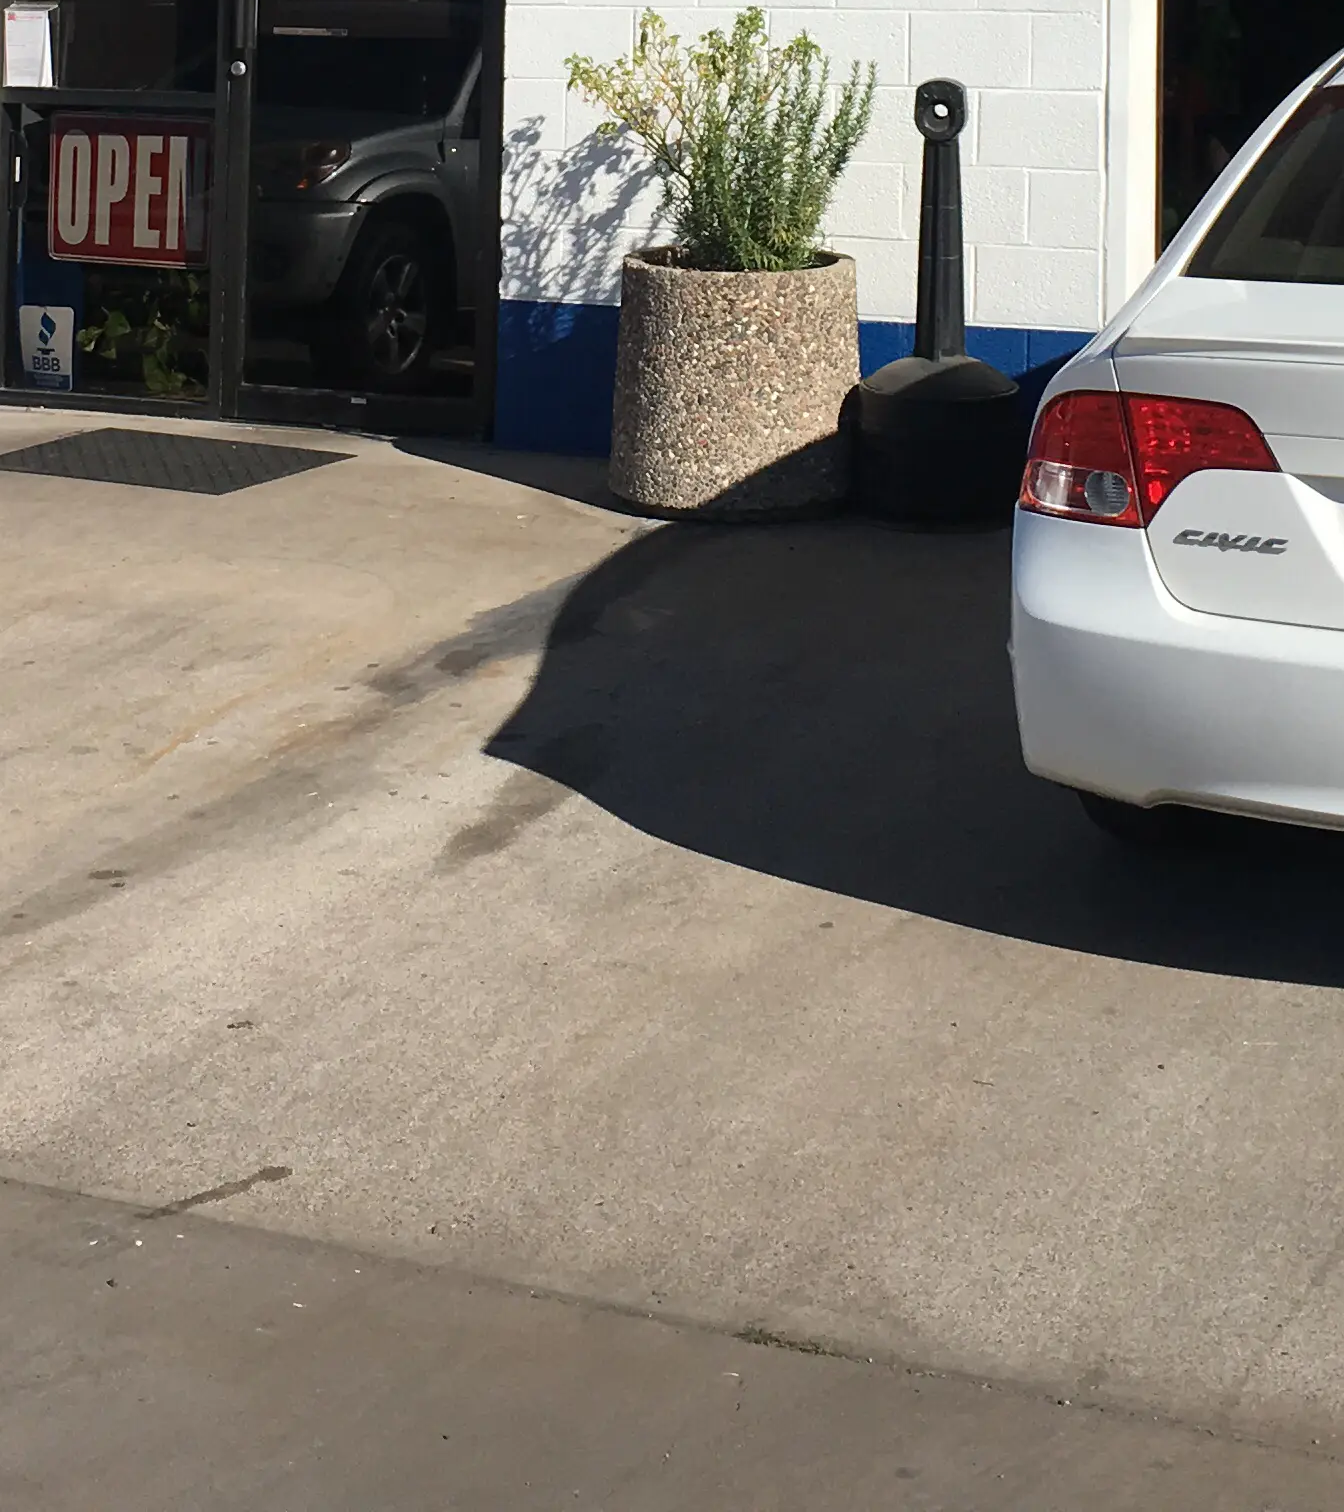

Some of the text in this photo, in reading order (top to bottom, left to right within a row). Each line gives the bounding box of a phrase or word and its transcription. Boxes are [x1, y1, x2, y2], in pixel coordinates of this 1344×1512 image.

[57, 129, 204, 251] OPEN
[32, 355, 61, 372] BBB
[1172, 529, 1289, 555] CIVIC
